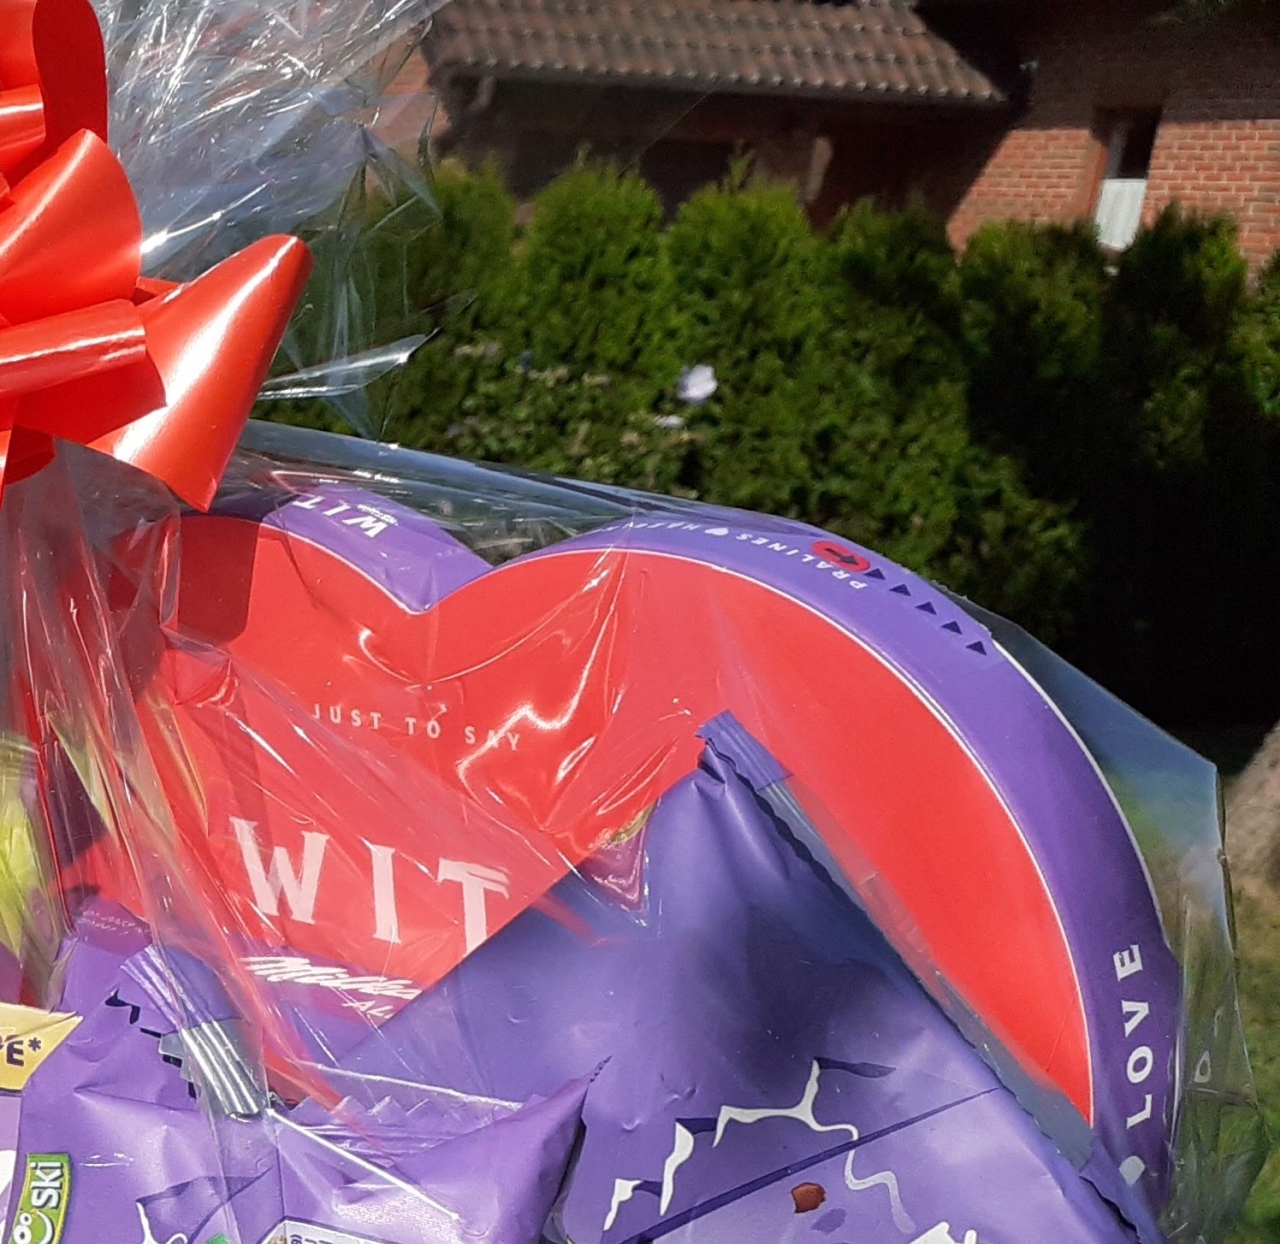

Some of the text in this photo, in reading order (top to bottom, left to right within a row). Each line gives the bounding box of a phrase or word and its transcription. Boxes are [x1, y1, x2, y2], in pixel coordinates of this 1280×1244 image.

[736, 533, 868, 590] PRALINES
[312, 703, 520, 751] JUST TO SAY
[1113, 944, 1154, 1130] LOVE
